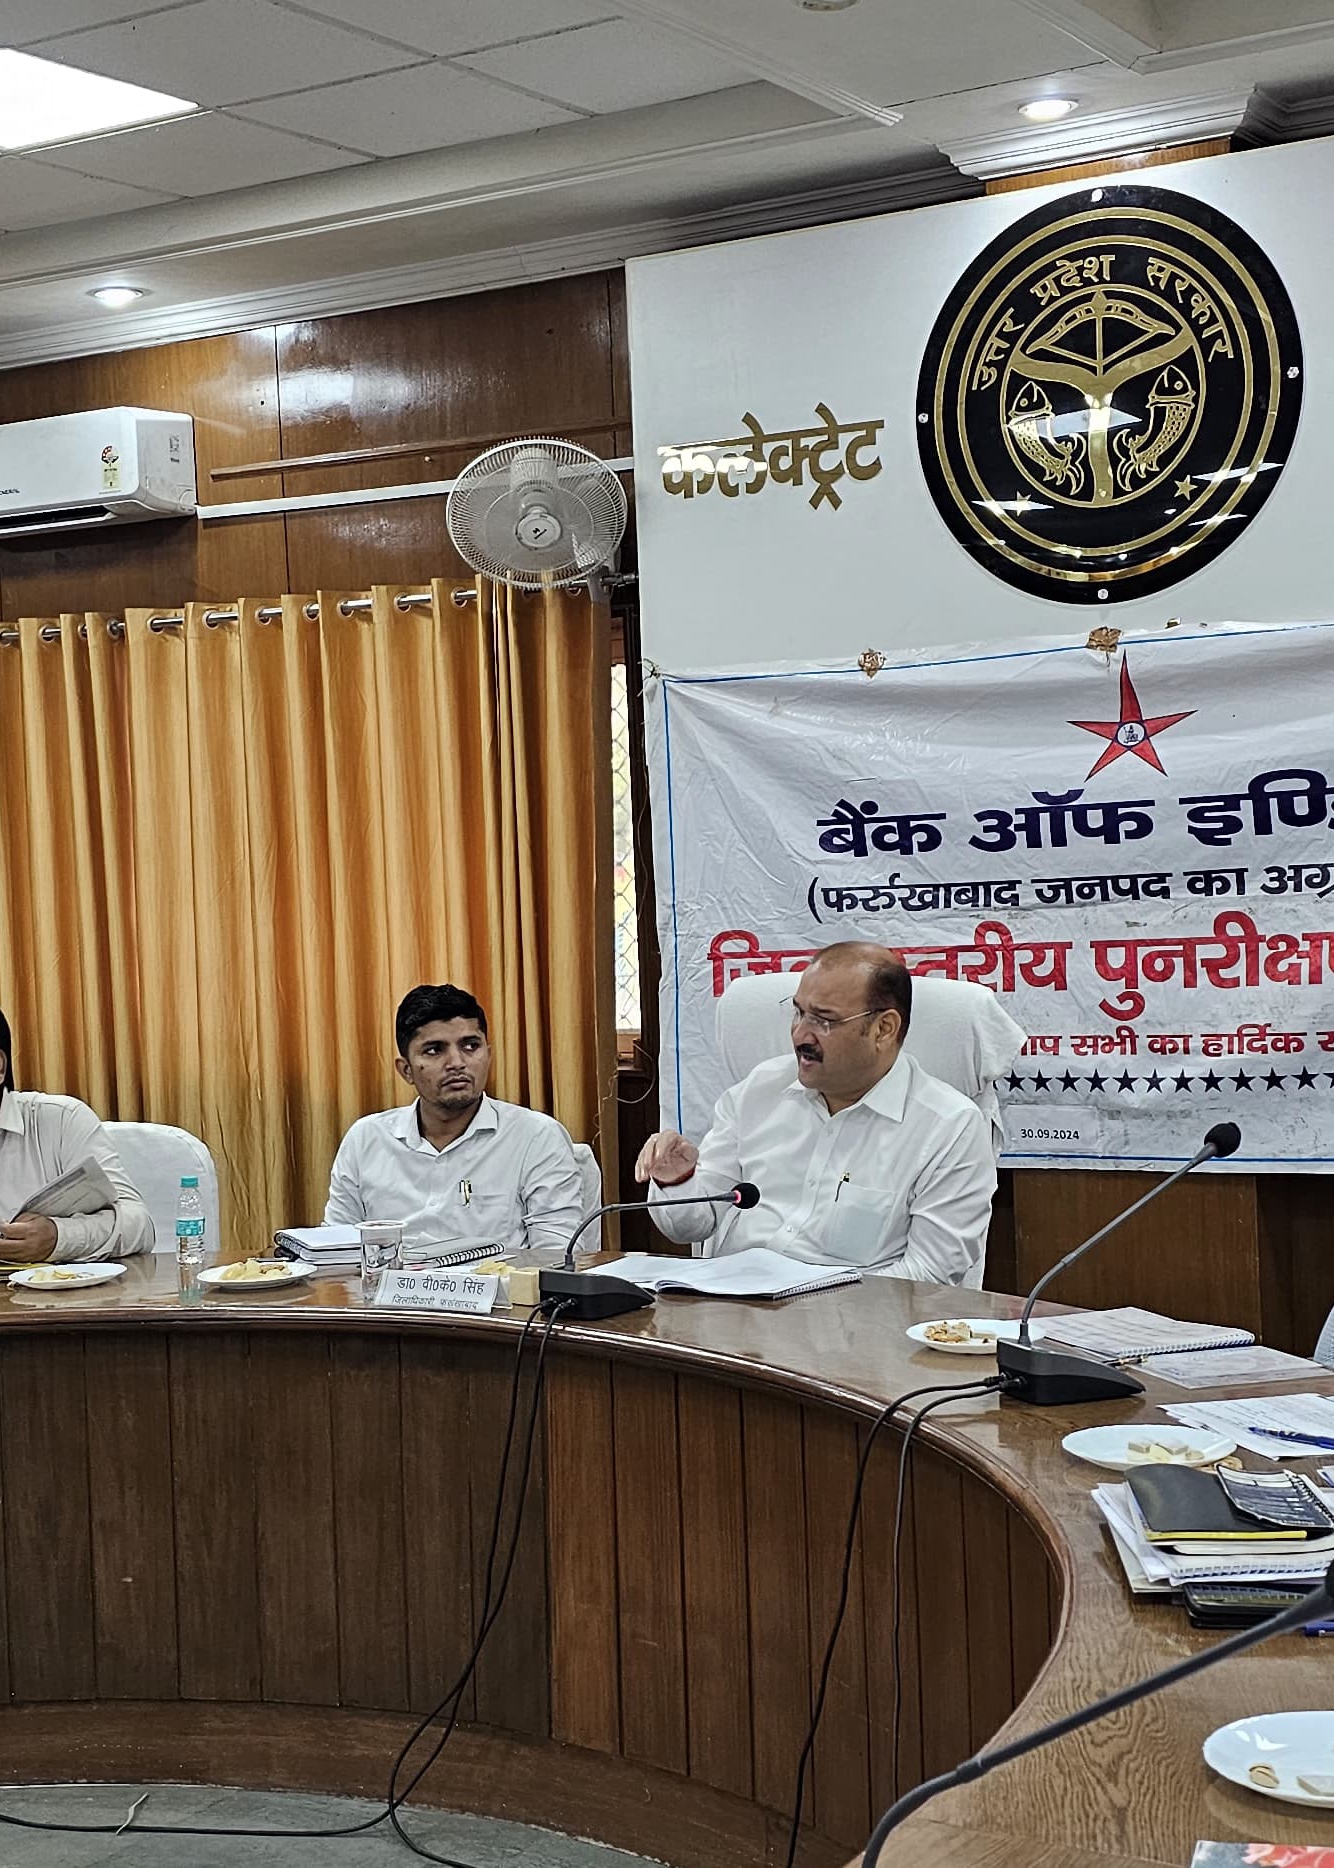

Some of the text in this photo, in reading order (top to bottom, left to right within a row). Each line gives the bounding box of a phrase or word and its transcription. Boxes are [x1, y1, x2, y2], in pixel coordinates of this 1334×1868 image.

[972, 254, 1235, 391] उत्तर प्रदेश सरकार
[657, 402, 885, 511] कलेक्ट्रेट
[816, 798, 947, 857] बैंक
[968, 788, 1156, 852] ऑफ
[1030, 872, 1173, 905] जनपद
[1183, 867, 1249, 897] का
[889, 920, 1073, 993] तरीय
[1070, 1024, 1139, 1056] सभी
[1146, 1034, 1193, 1055] का
[1200, 1023, 1308, 1058] हार्दिक
[1020, 1128, 1080, 1140] 30.09.2024
[462, 1276, 485, 1295] सिंह
